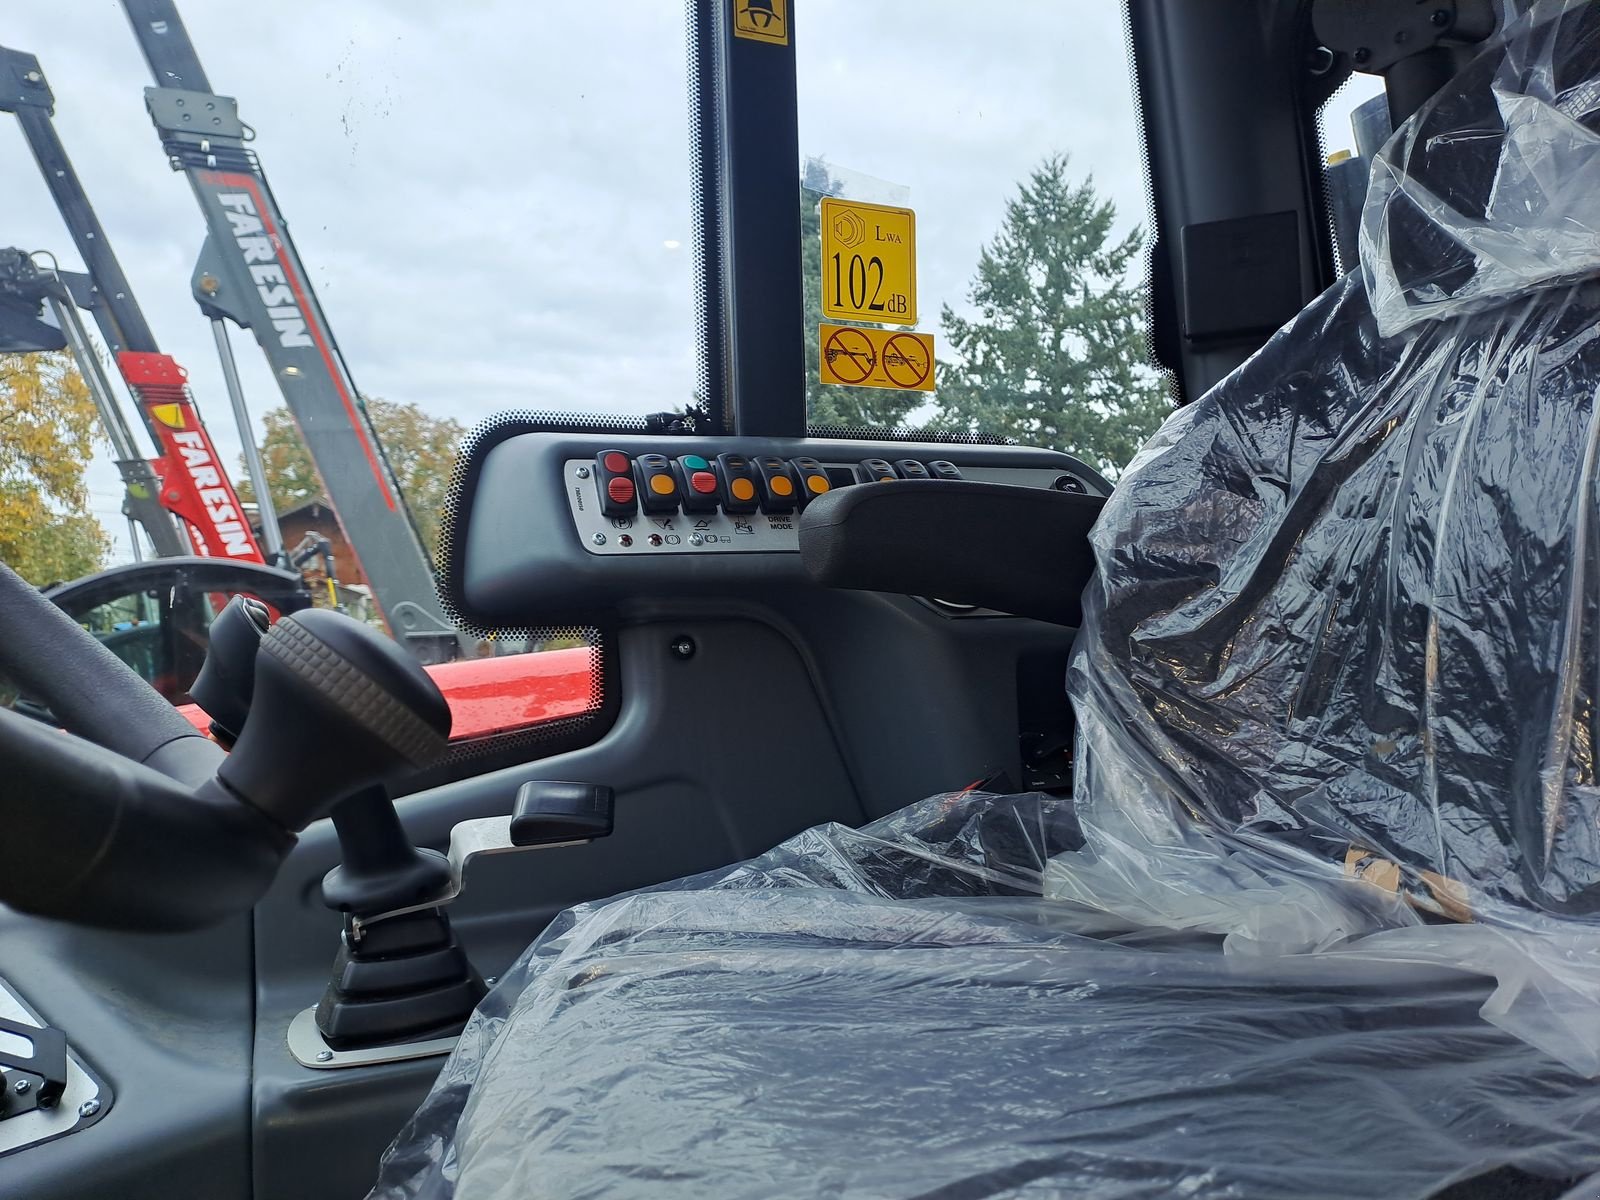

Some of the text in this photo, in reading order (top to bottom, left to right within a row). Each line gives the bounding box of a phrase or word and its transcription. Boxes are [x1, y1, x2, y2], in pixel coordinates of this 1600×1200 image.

[216, 192, 316, 348] FARESIN
[832, 251, 908, 314] 102 dB
[172, 431, 255, 556] FARESIN
